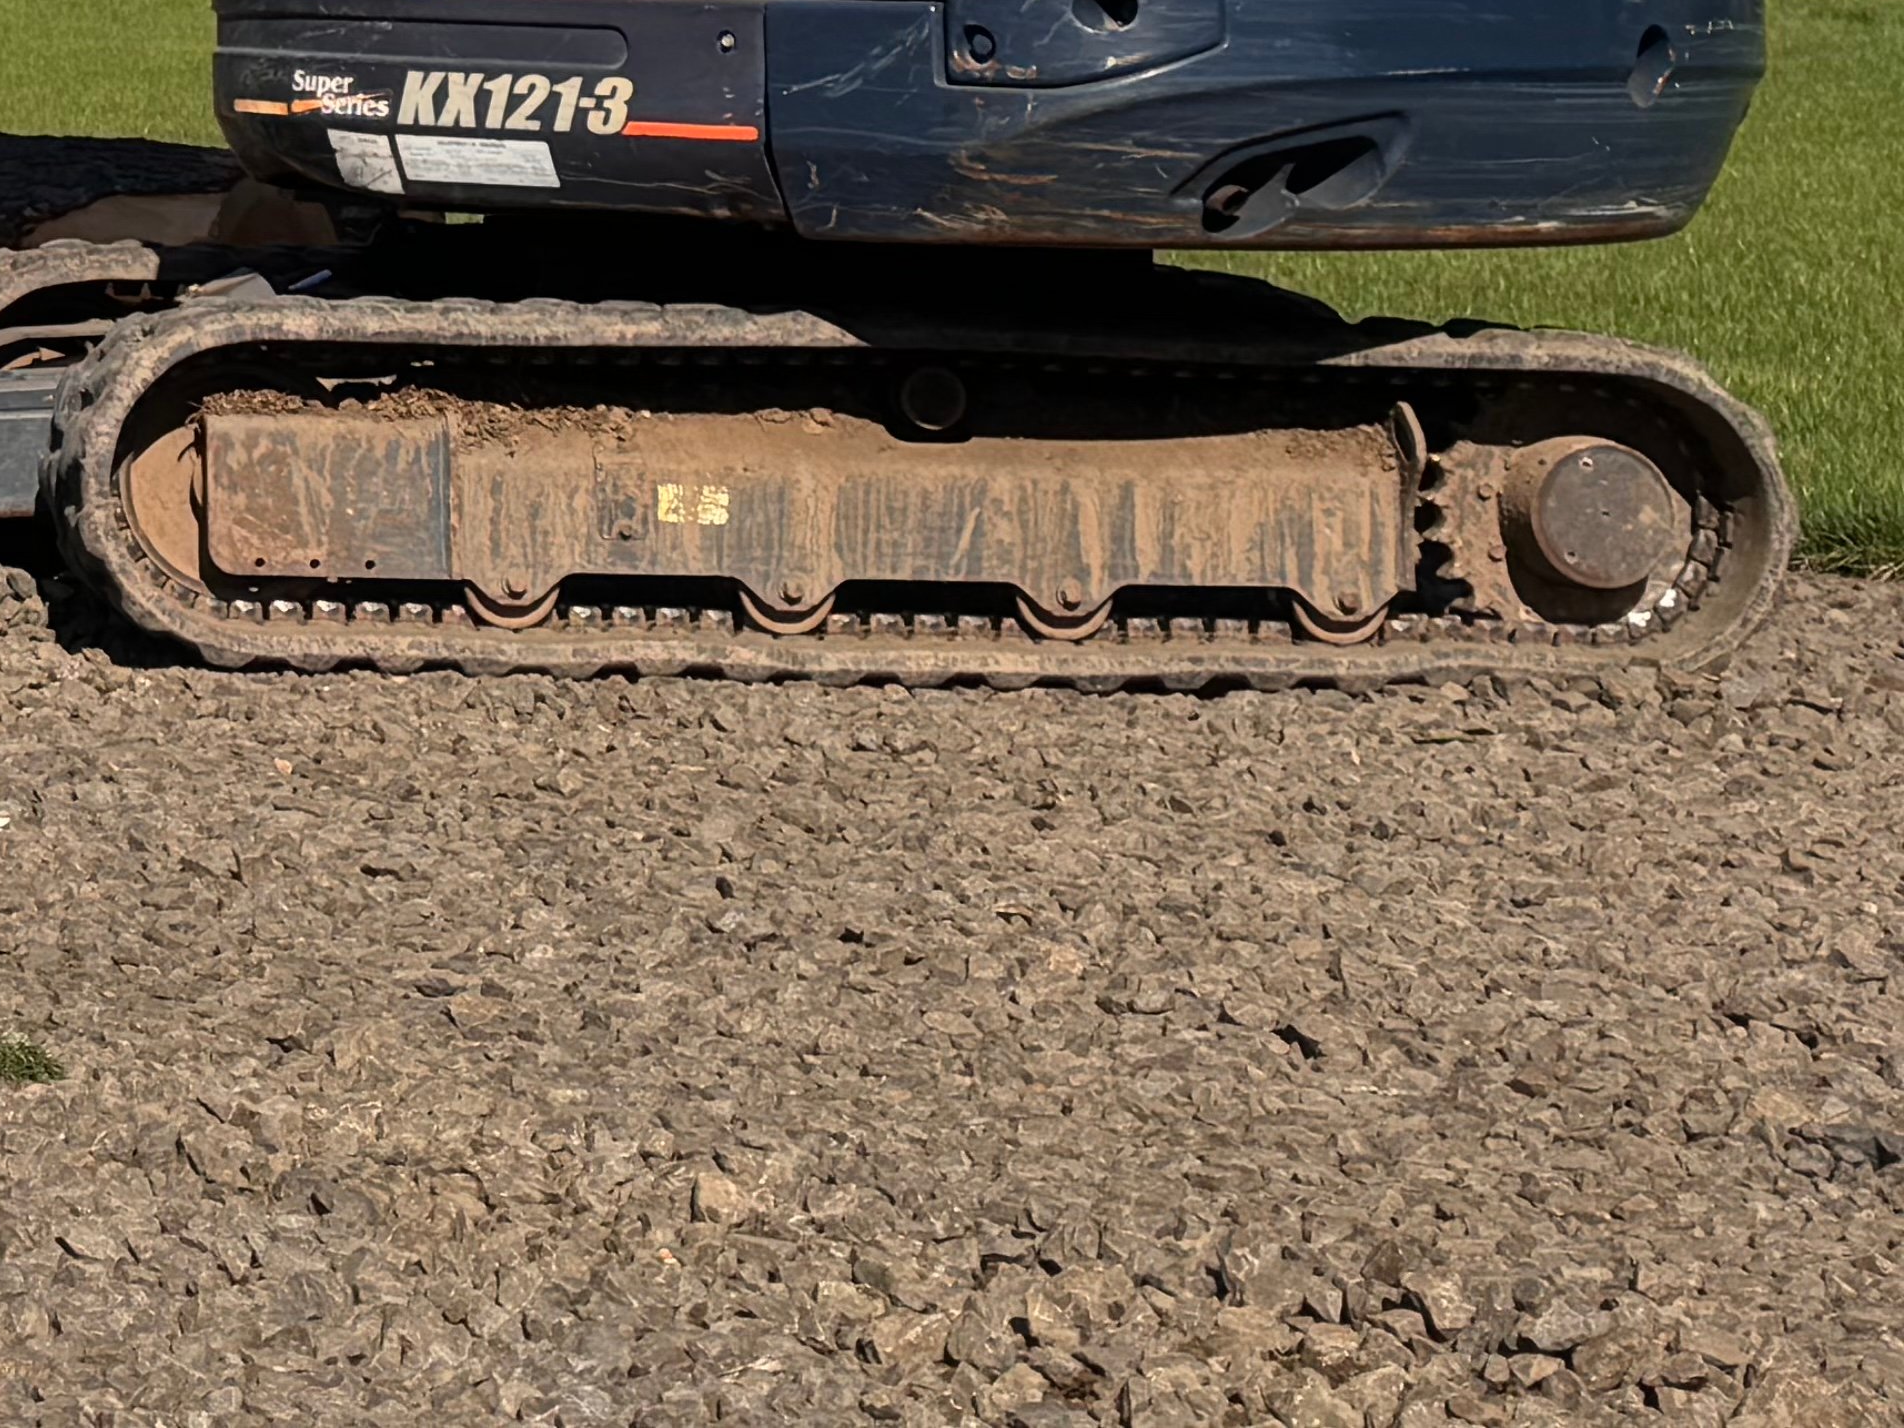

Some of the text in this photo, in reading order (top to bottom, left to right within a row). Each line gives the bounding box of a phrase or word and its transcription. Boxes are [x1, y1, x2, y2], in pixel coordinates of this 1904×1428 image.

[292, 69, 353, 93] Super
[320, 94, 389, 117] Series
[397, 70, 634, 135] KX121-3
